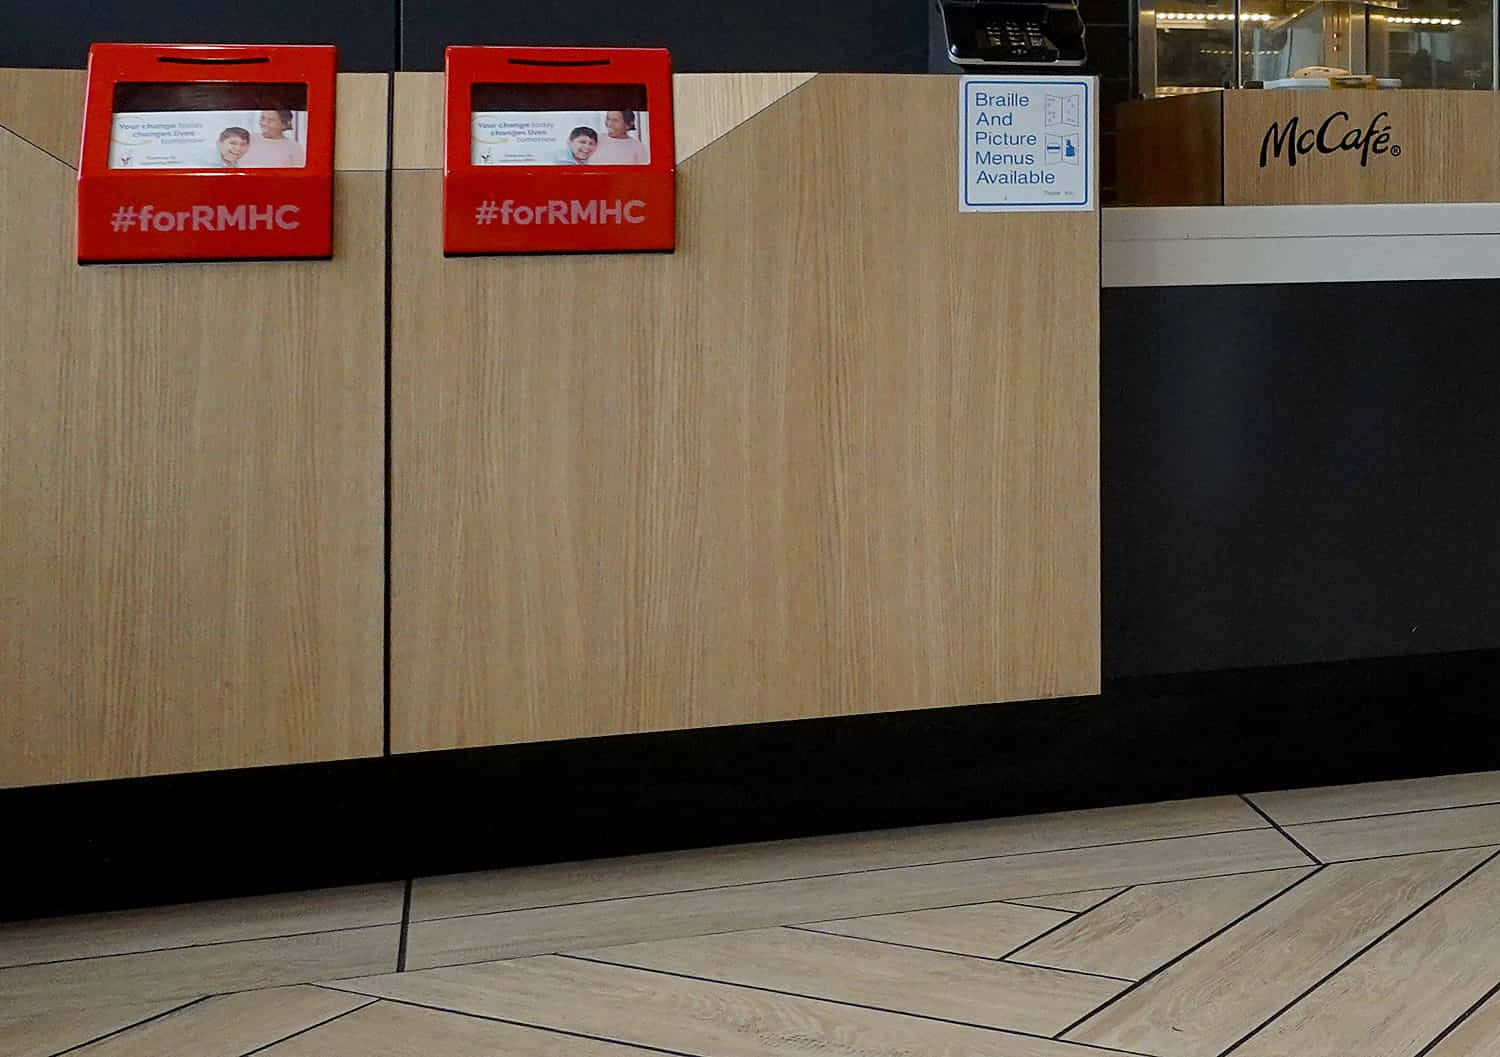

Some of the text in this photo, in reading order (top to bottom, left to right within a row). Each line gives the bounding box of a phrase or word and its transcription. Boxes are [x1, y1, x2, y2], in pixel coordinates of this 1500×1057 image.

[976, 92, 1029, 107] Braille
[119, 122, 140, 130] Your
[141, 122, 176, 130] change
[478, 121, 497, 129] Your
[499, 121, 529, 129] change
[976, 112, 1013, 126] And
[132, 130, 172, 138] changes
[976, 131, 1037, 145] Picture
[976, 151, 1034, 165] Menus
[976, 171, 1055, 184] Available
[109, 203, 301, 234] #forRMHC
[474, 198, 647, 228] #forRMHC
